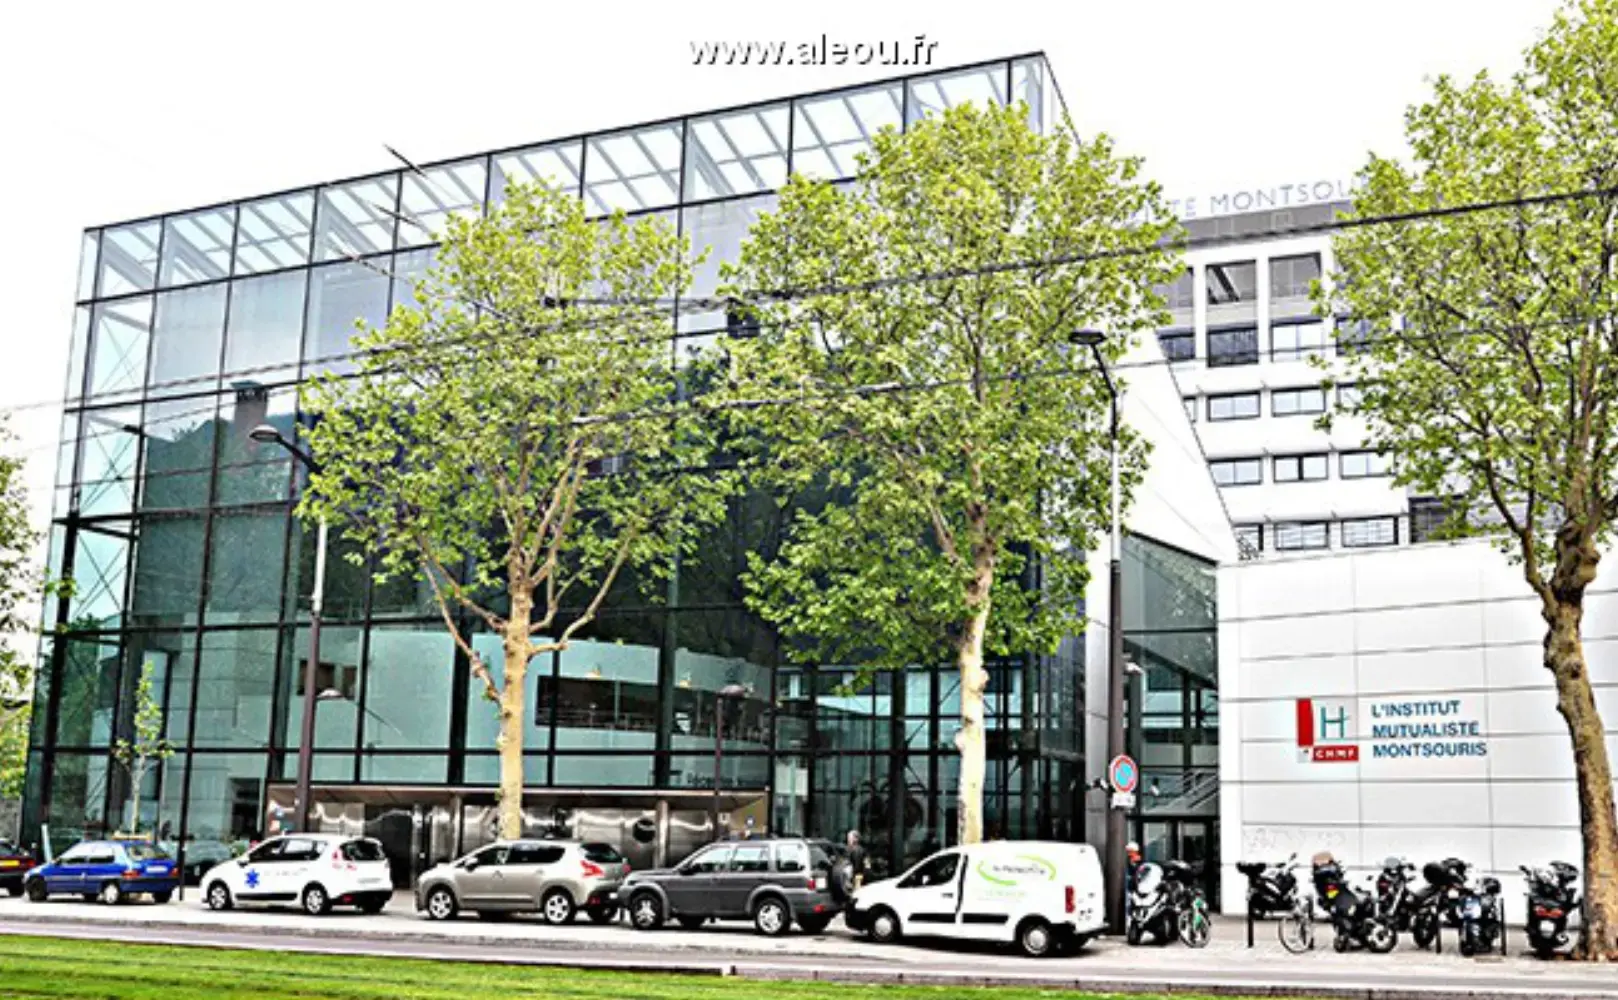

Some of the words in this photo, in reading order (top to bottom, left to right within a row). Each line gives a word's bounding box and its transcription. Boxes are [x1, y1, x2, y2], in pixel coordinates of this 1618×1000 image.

[1371, 699, 1461, 718] L'INSTITUT
[1372, 720, 1480, 738] MUTUALISTE
[1372, 741, 1488, 758] MONTSOURIS
